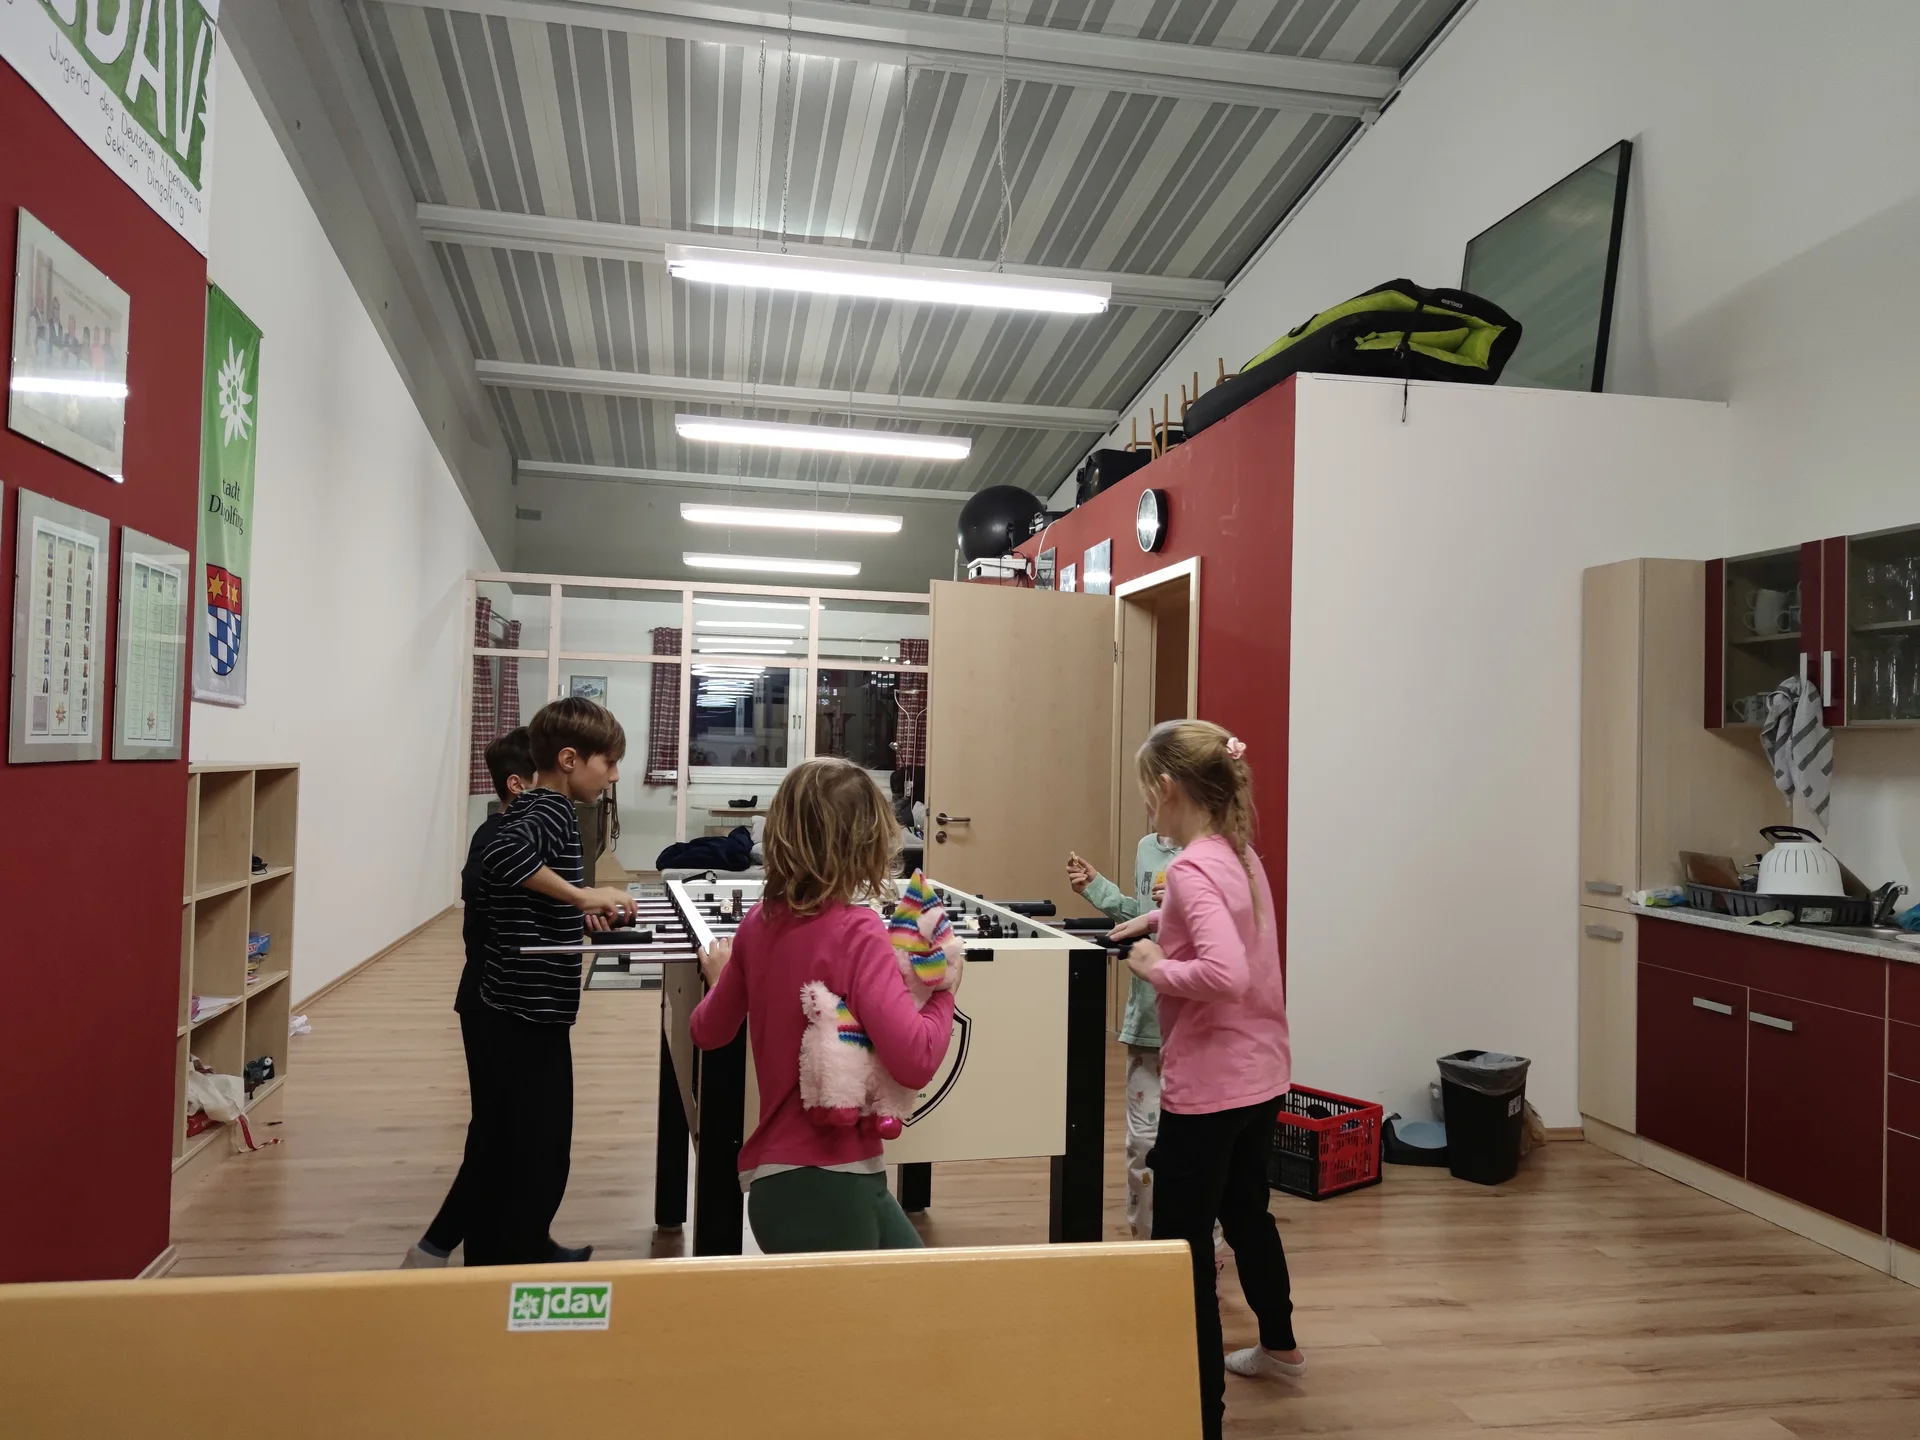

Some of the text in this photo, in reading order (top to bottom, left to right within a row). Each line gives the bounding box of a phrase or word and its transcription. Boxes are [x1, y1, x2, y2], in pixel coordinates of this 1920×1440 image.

[49, 32, 202, 213] Jugend des Deutschen Alpenvereins
[105, 126, 138, 174] Sektion
[222, 478, 240, 502] tadt
[540, 1286, 607, 1320] jdav
